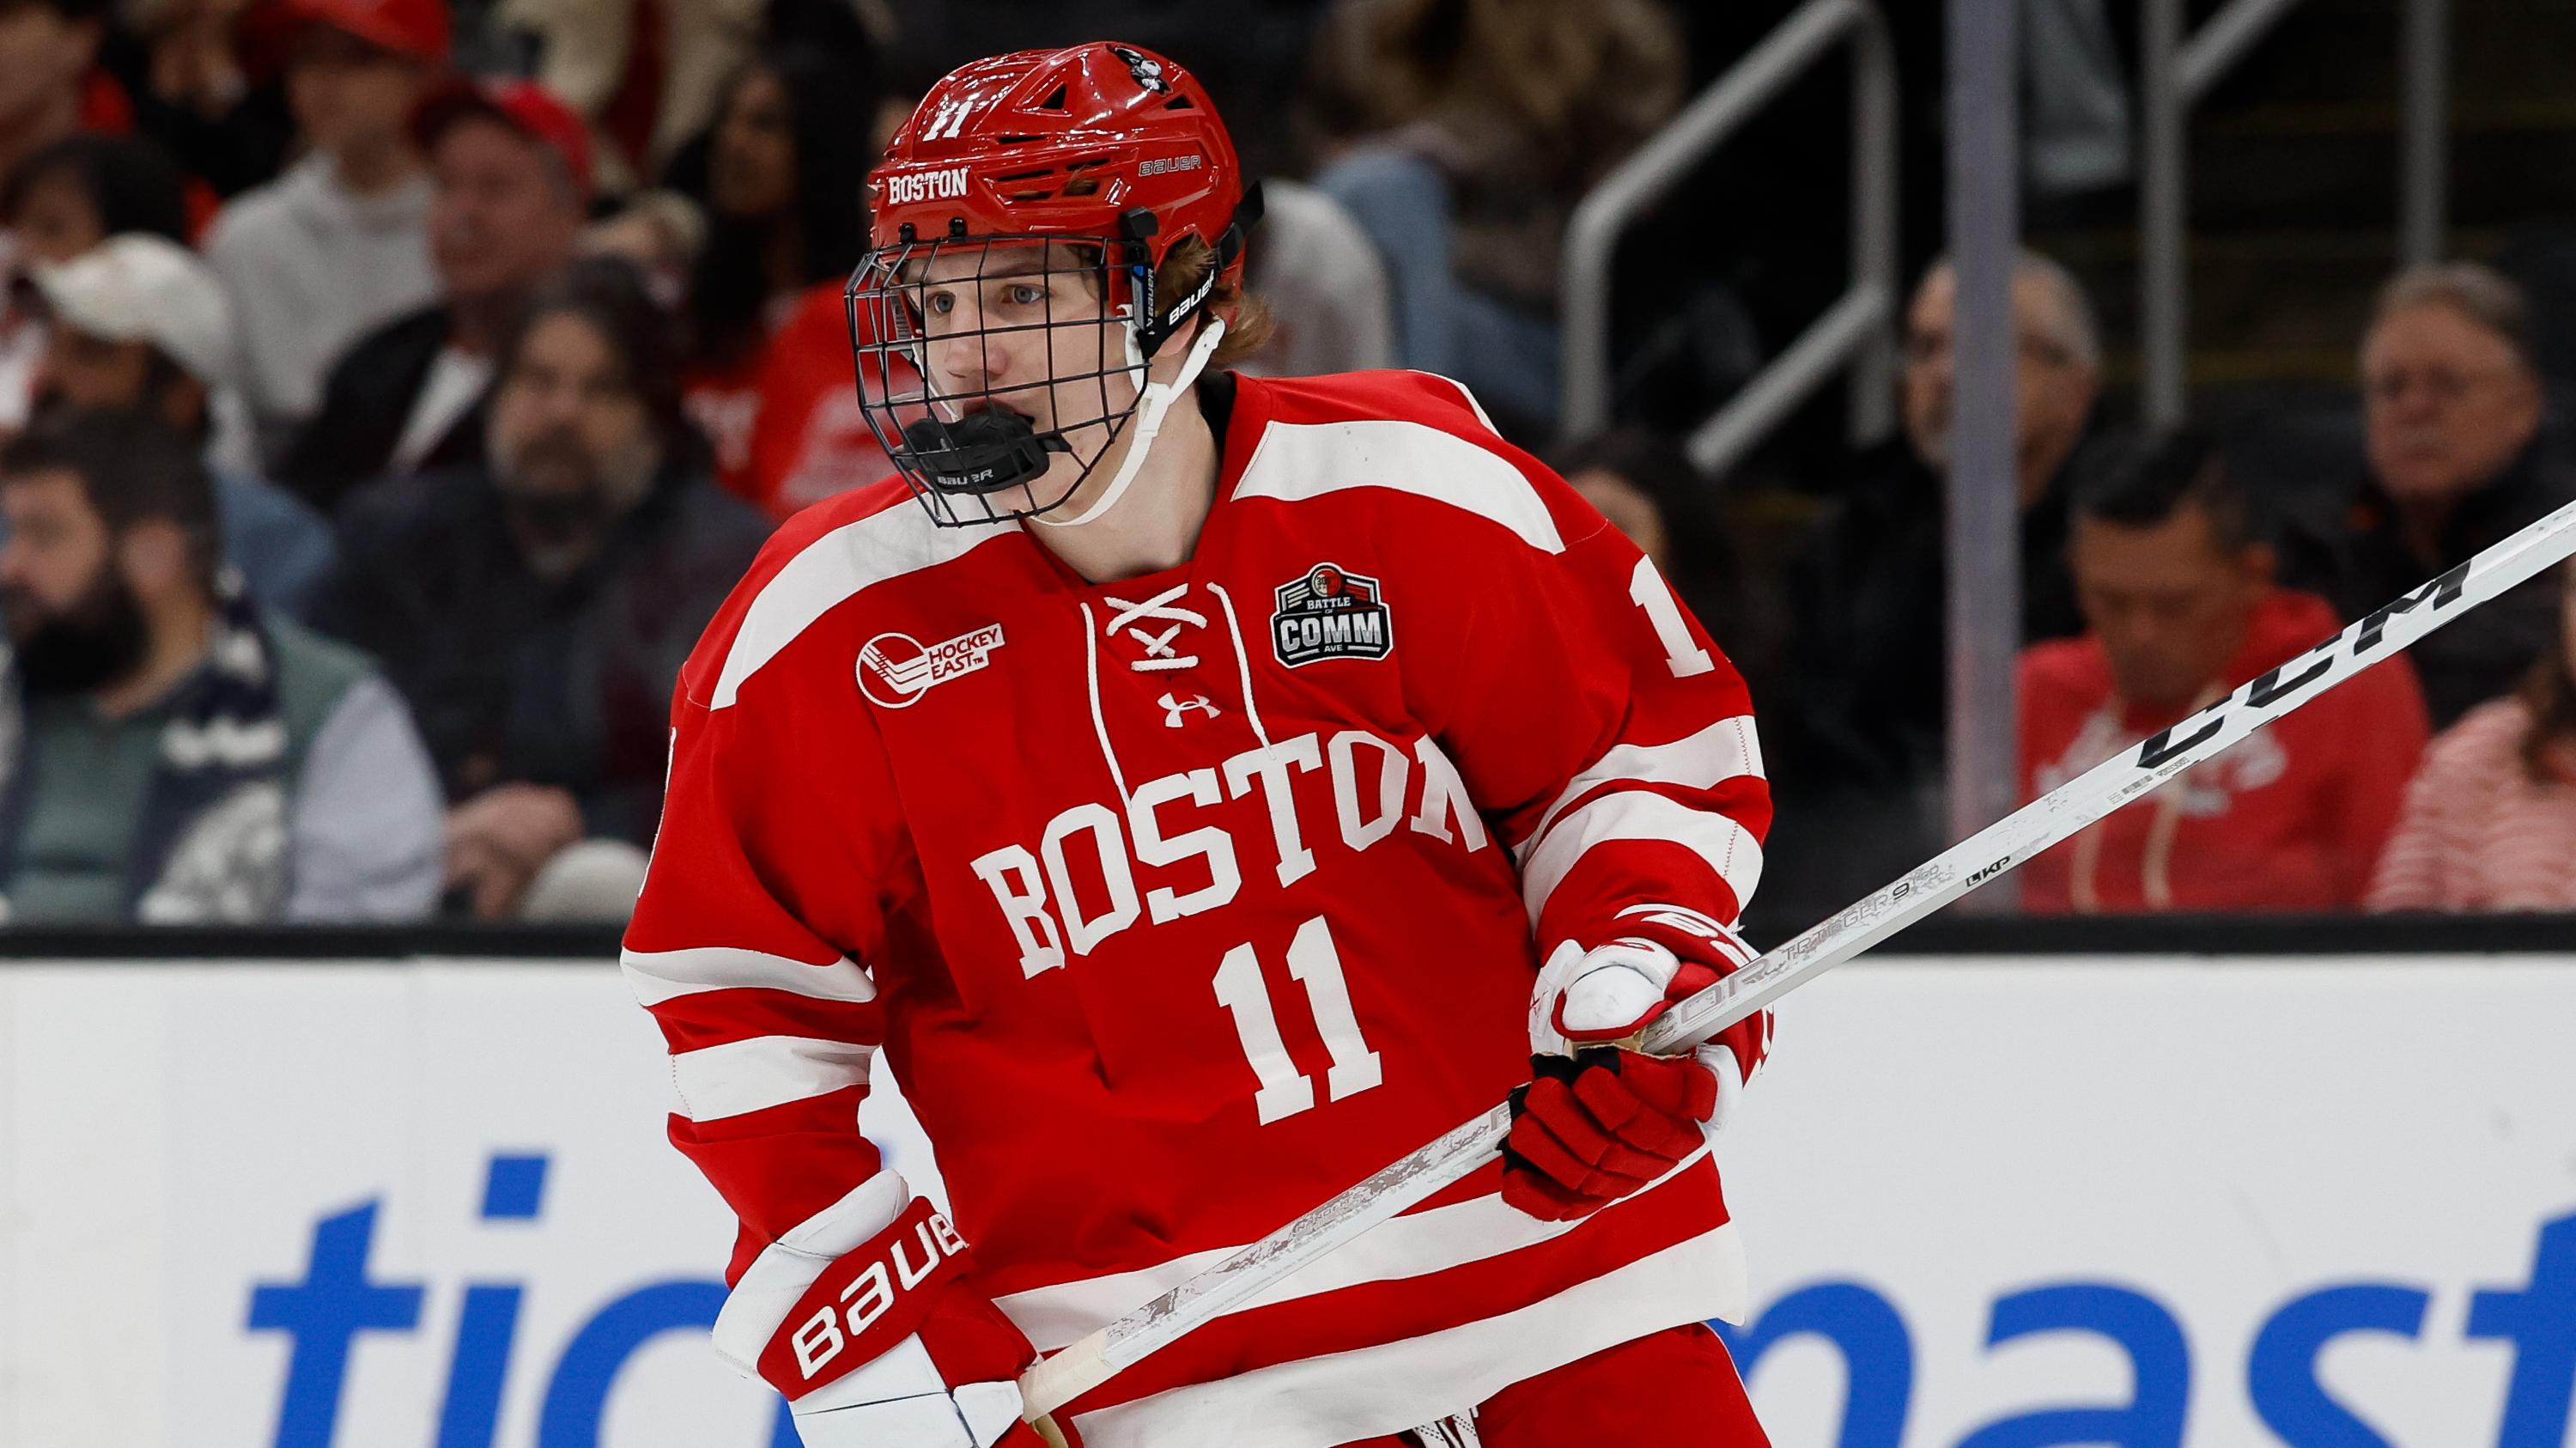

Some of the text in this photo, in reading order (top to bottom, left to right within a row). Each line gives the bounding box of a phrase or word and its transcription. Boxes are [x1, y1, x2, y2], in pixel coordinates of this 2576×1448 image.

[922, 100, 974, 142] 11
[889, 167, 970, 205] BOSTON
[1139, 155, 1202, 178] BAUER
[1306, 596, 1352, 611] BATTLE
[928, 628, 998, 665] HOCKEY
[1279, 611, 1382, 653] COMM
[1323, 644, 1343, 653] AVE
[2136, 560, 2472, 770] CCM
[970, 730, 1488, 980] BOSTON
[1892, 882, 1911, 899] 9
[1212, 914, 1383, 1127] 11
[791, 1212, 969, 1381] BAUE
